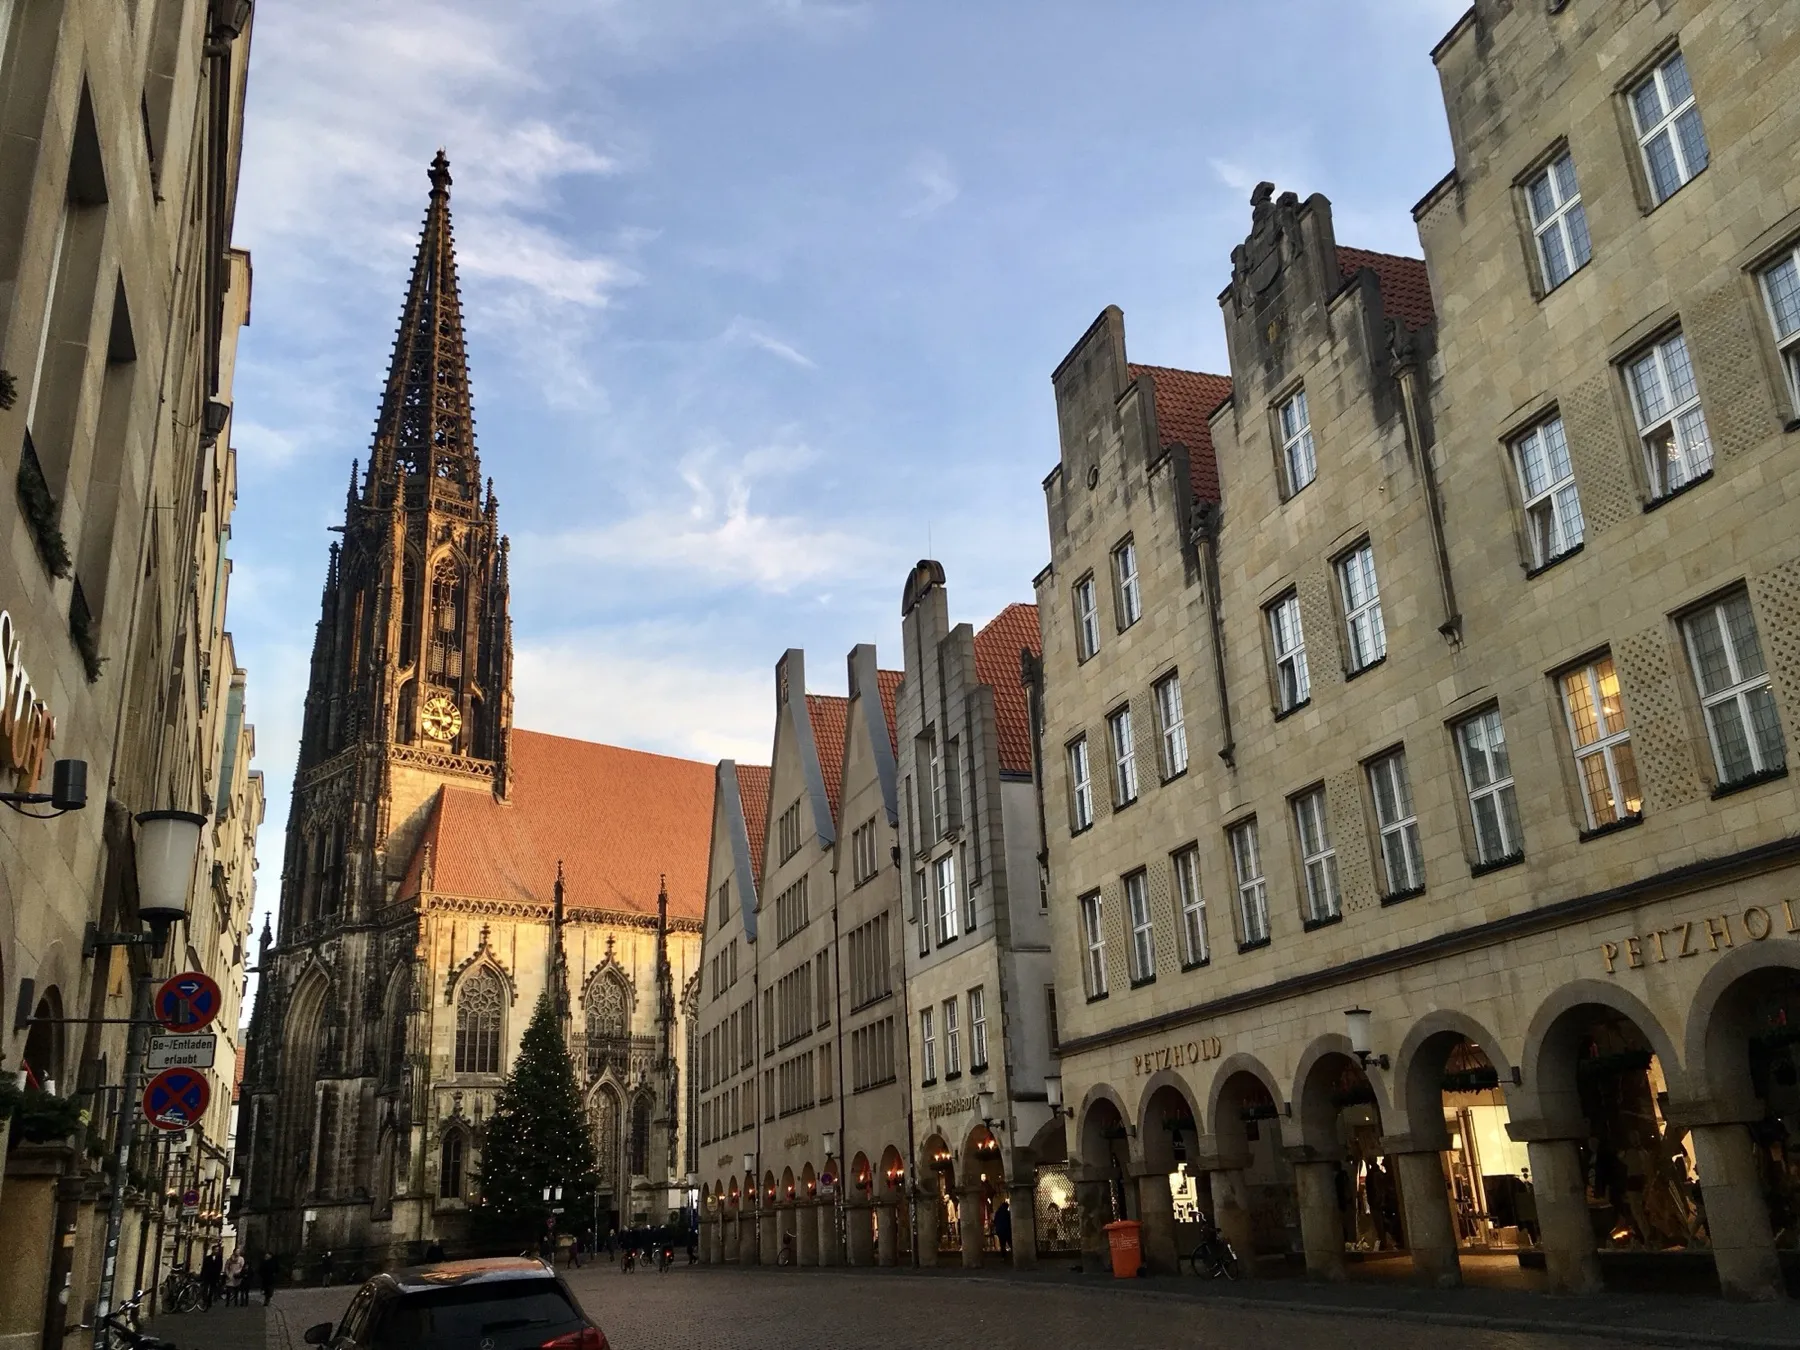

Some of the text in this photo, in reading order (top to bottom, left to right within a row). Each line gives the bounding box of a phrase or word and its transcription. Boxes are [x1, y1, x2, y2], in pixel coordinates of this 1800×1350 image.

[152, 1039, 213, 1050] Be-/Entladen
[164, 1054, 198, 1065] erlaubt
[1134, 1036, 1222, 1076] PETZHOLD
